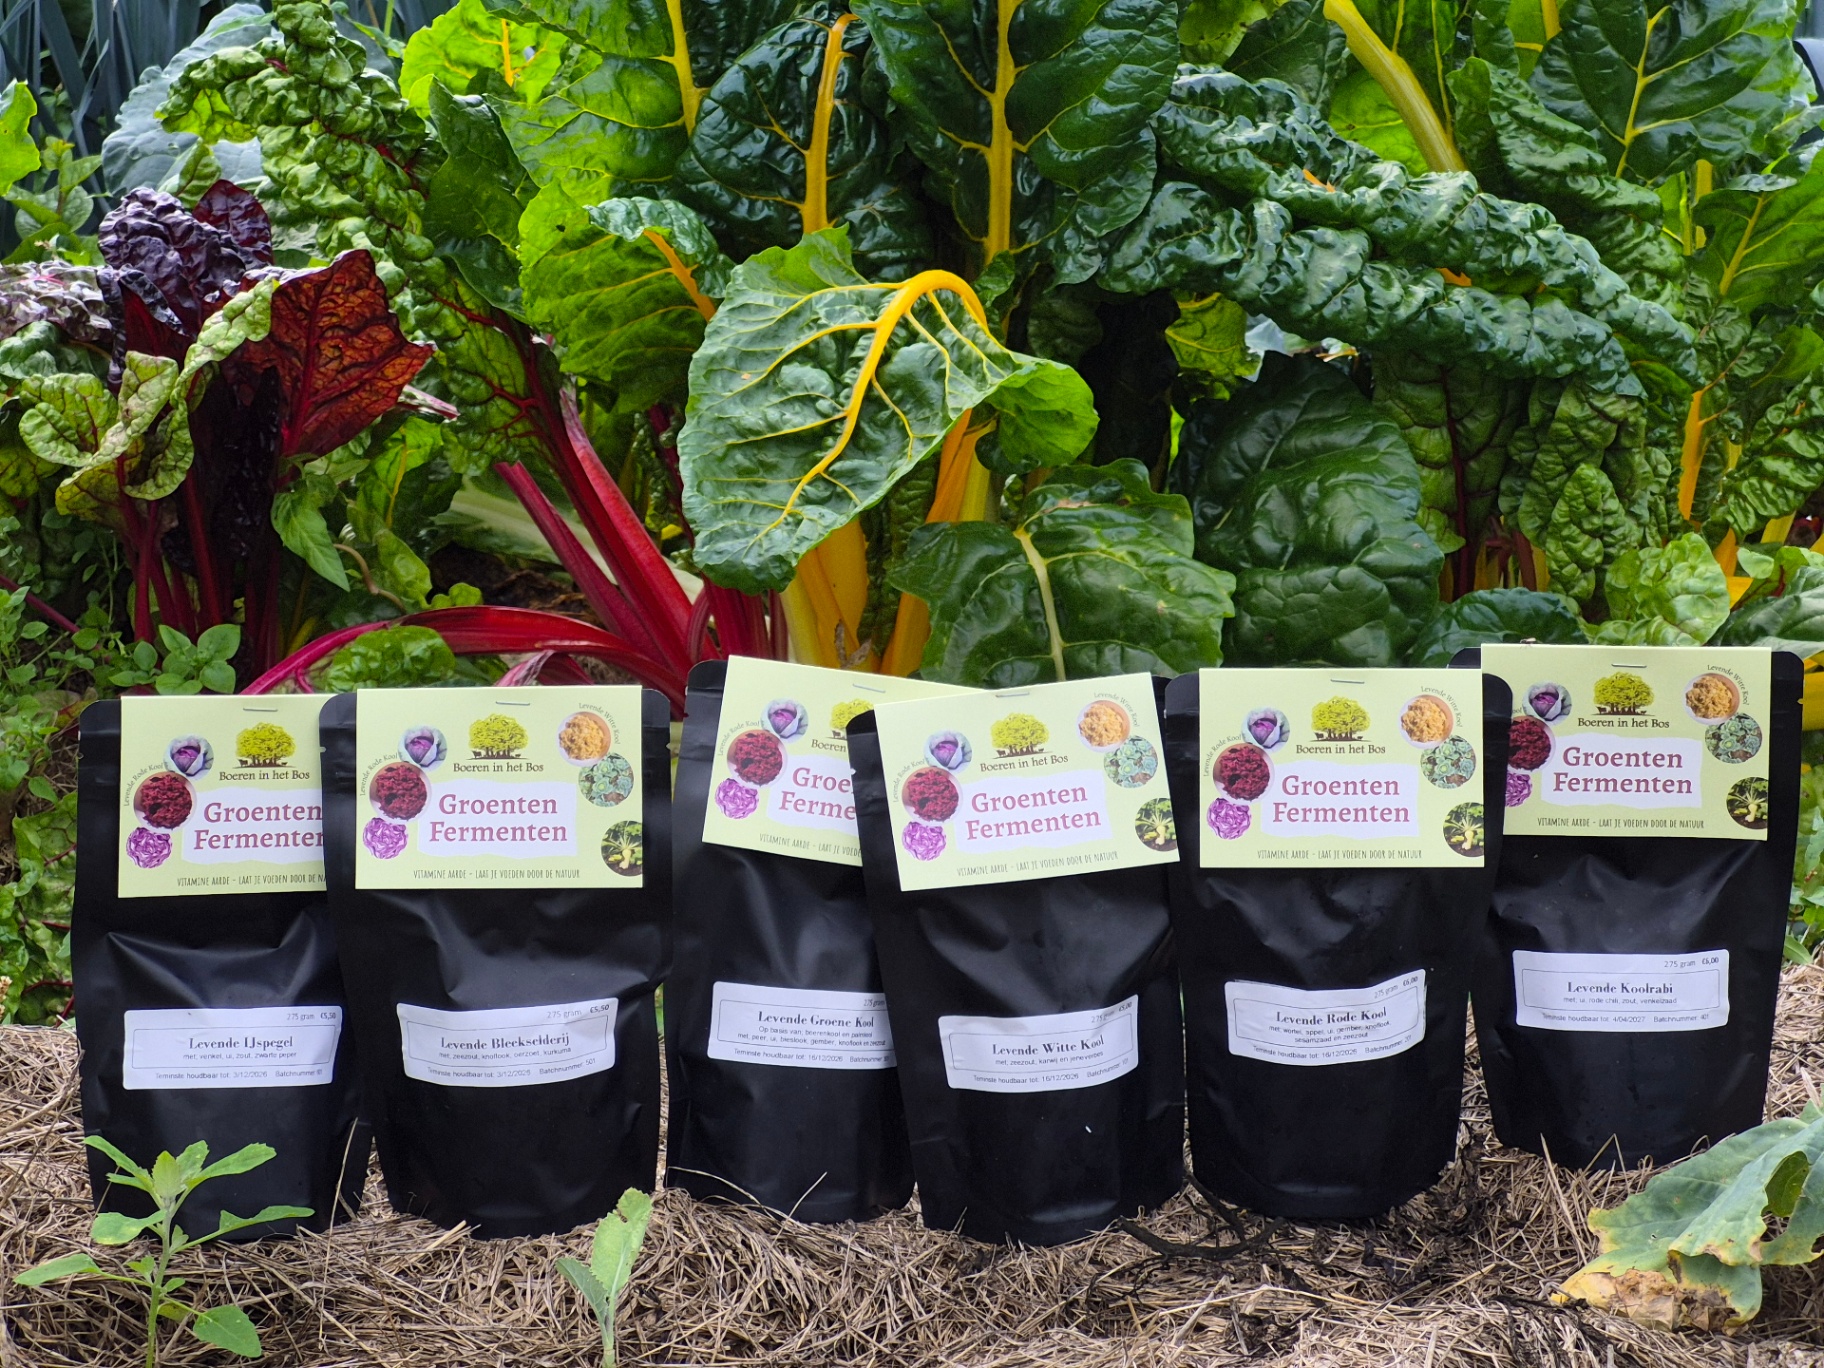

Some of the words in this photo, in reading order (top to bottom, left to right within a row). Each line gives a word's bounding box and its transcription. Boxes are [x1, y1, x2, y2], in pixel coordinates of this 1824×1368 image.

[1578, 718, 1614, 728] Boeren
[1618, 718, 1628, 728] in
[1632, 718, 1648, 728] het
[1652, 719, 1670, 728] Bos
[812, 740, 846, 752] Boeren
[1296, 744, 1332, 754] Boeren
[1336, 744, 1345, 754] in
[1348, 744, 1364, 754] het
[1368, 744, 1386, 754] Bos
[980, 760, 1016, 772] Boeren
[1019, 760, 1028, 768] in
[1032, 756, 1048, 768] het
[1051, 754, 1068, 765] Bos
[1562, 747, 1682, 768] Groenten
[219, 771, 255, 781] Boeren
[259, 771, 269, 780] in
[273, 770, 288, 780] het
[292, 769, 310, 780] Bos
[454, 763, 490, 772] Boeren
[493, 763, 502, 772] in
[506, 762, 522, 772] het
[526, 763, 544, 772] Bos
[792, 768, 853, 794] Groe
[1282, 776, 1399, 796] Groenten
[1553, 772, 1692, 794] Fermenten
[439, 794, 557, 814] Groenten
[779, 791, 856, 820] Ferme
[971, 787, 1087, 813] Groenten
[204, 803, 322, 822] Groenten
[1272, 802, 1410, 823] Fermenten
[430, 822, 567, 842] Fermenten
[966, 812, 1100, 840] Fermenten
[1538, 818, 1570, 827] VITAMINE
[1572, 818, 1590, 827] AARDE
[1598, 818, 1612, 828] LAAT
[1614, 818, 1620, 828] JE
[1623, 818, 1649, 828] VOEDEN
[1651, 818, 1668, 828] DOOR
[1670, 819, 1678, 828] DE
[1680, 819, 1704, 828] NATUUR
[760, 834, 790, 846] VITAMINE
[956, 866, 988, 876] VITAMINE
[990, 864, 1008, 874] AARDE
[1016, 862, 1030, 872] LAAT
[1031, 860, 1038, 870] JE
[1040, 858, 1064, 869] VOEDEN
[1066, 856, 1082, 866] DOOR
[1084, 854, 1092, 864] DE
[1094, 851, 1118, 862] NATUUR
[1257, 850, 1289, 860] VITAMINE
[1291, 850, 1310, 860] AARDE
[1318, 850, 1332, 859] LAAT
[1333, 850, 1340, 860] JE
[1342, 850, 1367, 859] VOEDEN
[1370, 850, 1386, 859] DOOR
[1388, 850, 1395, 859] DE
[1398, 850, 1422, 859] NATUUR
[177, 877, 209, 886] VITAMINE
[212, 876, 230, 885] AARDE
[238, 876, 252, 884] LAAT
[254, 875, 261, 886] JE
[263, 874, 287, 884] VOEDEN
[290, 874, 306, 883] DOOR
[308, 874, 316, 883] DE
[413, 870, 445, 879] VITAMINE
[448, 870, 466, 878] AARDE
[475, 870, 488, 878] LAAT
[490, 870, 497, 880] JE
[500, 870, 524, 878] VOEDEN
[527, 869, 542, 878] DOOR
[545, 869, 552, 878] DE
[556, 869, 580, 878] NATUUR
[1664, 960, 1678, 968] 275
[1680, 960, 1696, 968] gram
[1374, 990, 1384, 999] 275
[1568, 982, 1617, 994] Levende
[1620, 982, 1672, 994] Koolrabi
[564, 1010, 582, 1018] gram
[590, 1004, 610, 1014] €5,50
[758, 1010, 807, 1024] Levende
[810, 1014, 851, 1027] Groene
[856, 1016, 874, 1028] Kool
[1276, 1011, 1323, 1025] Levende
[1327, 1012, 1357, 1024] Rode
[1360, 1006, 1386, 1020] Kool
[189, 1037, 240, 1049] Levende
[244, 1036, 292, 1051] IJspegel
[441, 1036, 488, 1050] Levende
[492, 1032, 570, 1049] Bleekselderij
[992, 1044, 1038, 1056] Levende
[1042, 1042, 1077, 1054] Witte
[1080, 1034, 1104, 1050] Kool
[586, 1058, 596, 1066] 501
